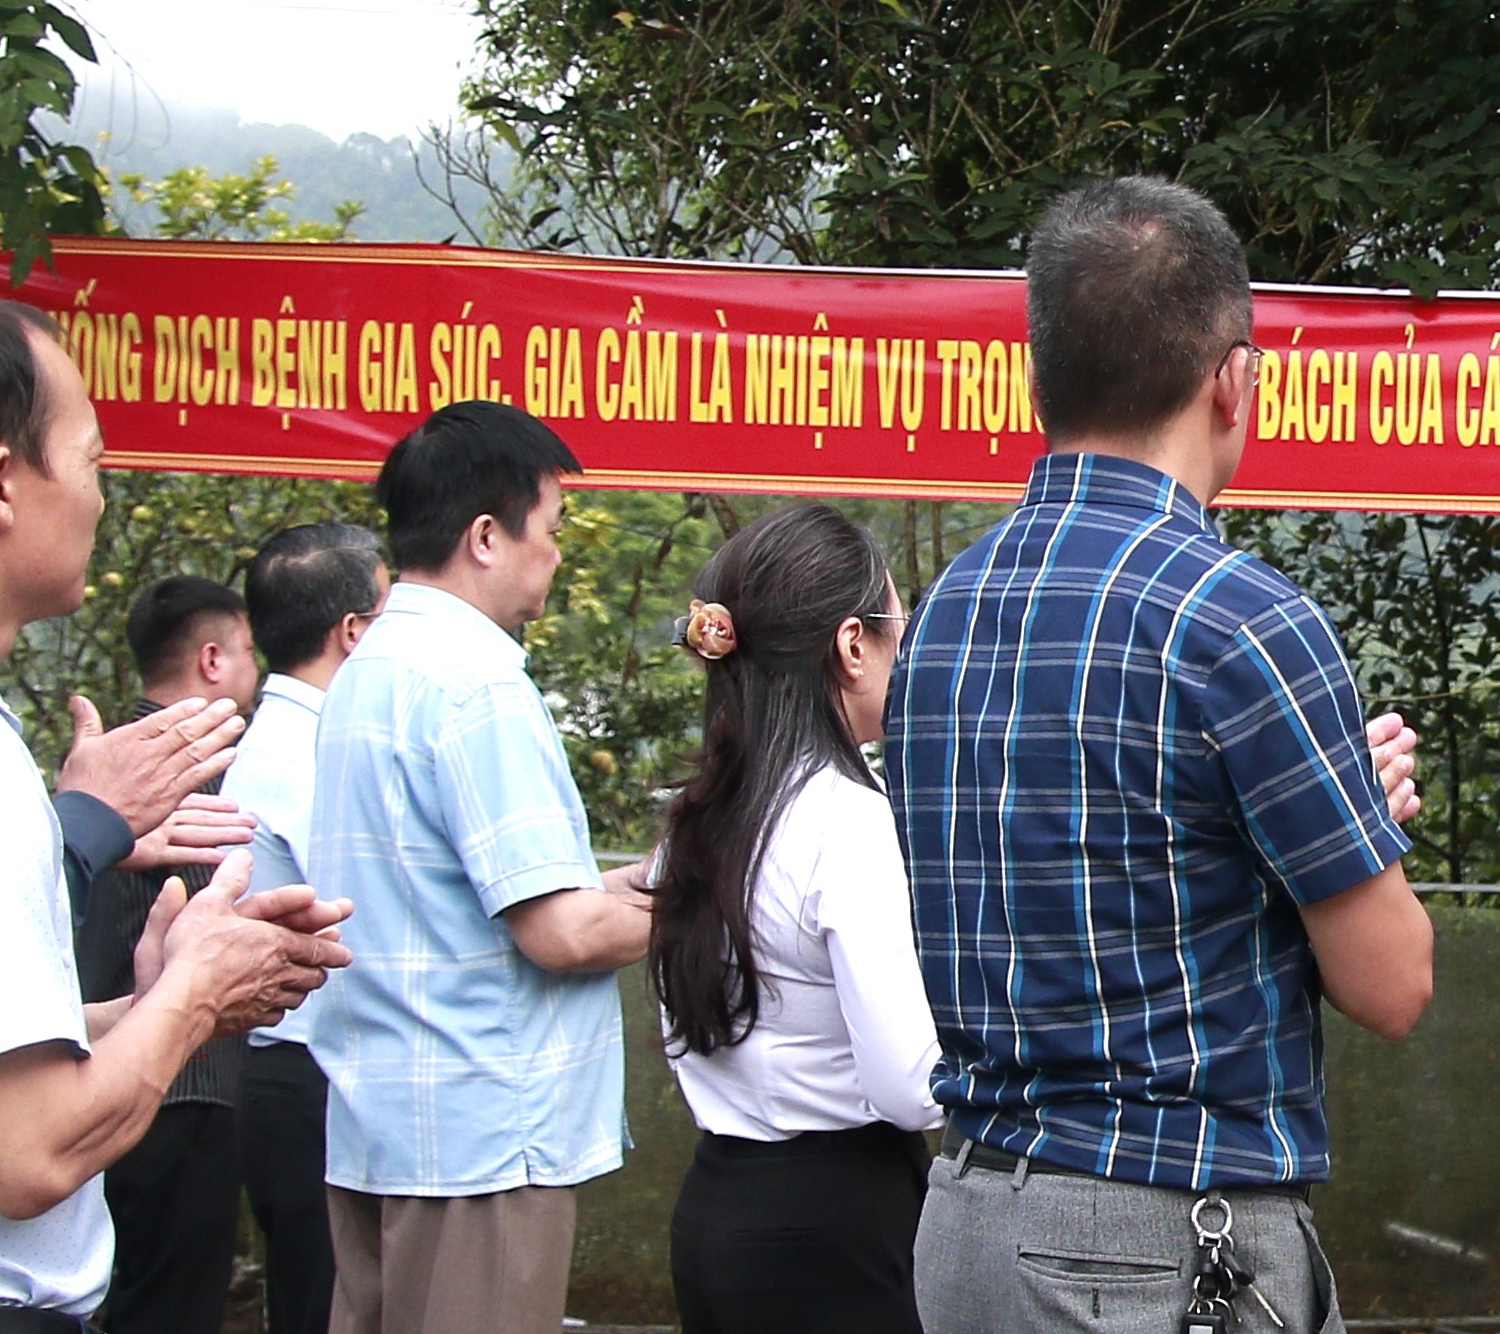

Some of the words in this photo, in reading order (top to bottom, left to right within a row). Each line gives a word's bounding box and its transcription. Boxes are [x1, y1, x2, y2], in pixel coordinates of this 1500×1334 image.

[49, 280, 142, 402] ỐNG
[155, 315, 240, 424] DỊCH
[252, 296, 347, 430] BỆNH
[359, 320, 418, 412] GIA
[525, 326, 584, 418] GIA
[596, 296, 678, 421] CẦM
[690, 310, 732, 423] LÀ
[745, 314, 865, 448] NHIỆM
[877, 338, 926, 451] VỤ
[937, 340, 1044, 454] TRỌN
[1256, 327, 1358, 443] BÁCH
[1370, 324, 1444, 445] CỦA
